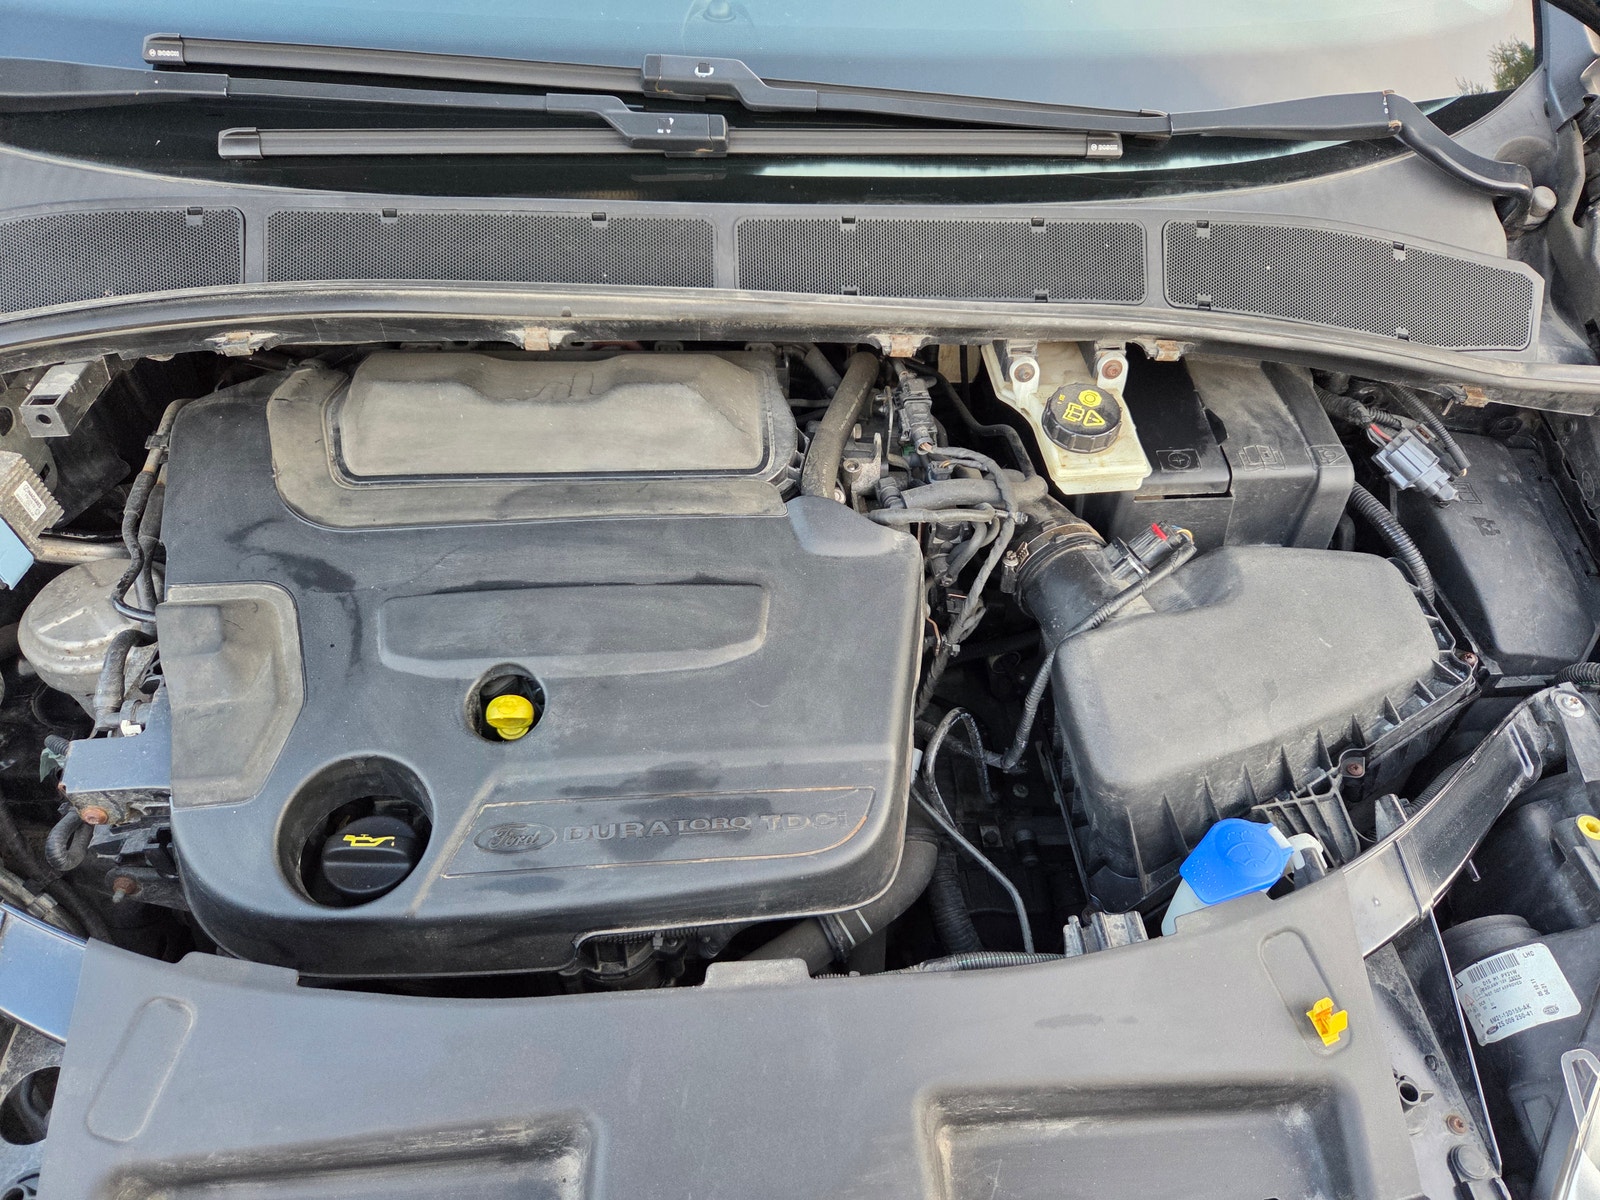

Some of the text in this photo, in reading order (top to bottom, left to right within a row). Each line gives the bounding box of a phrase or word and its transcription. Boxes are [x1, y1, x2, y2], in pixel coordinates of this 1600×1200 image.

[157, 49, 179, 57] BOSCH
[488, 810, 849, 849] Ford DURATORQ TDCi
